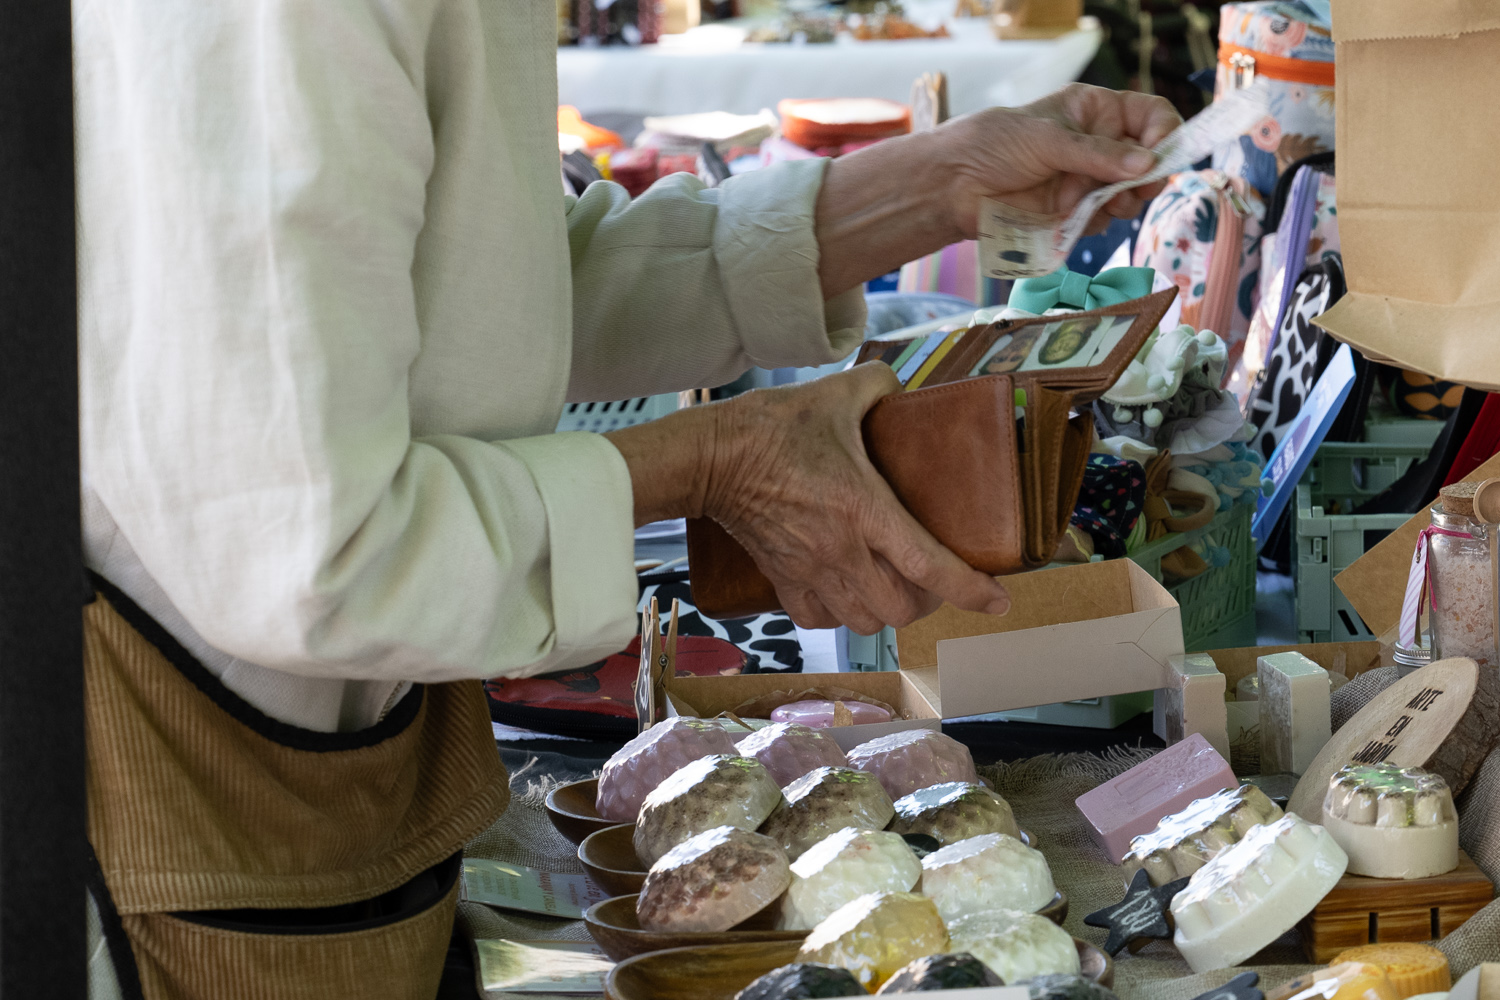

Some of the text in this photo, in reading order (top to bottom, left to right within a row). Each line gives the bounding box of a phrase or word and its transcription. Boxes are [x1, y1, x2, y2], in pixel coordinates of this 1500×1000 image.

[1405, 687, 1444, 712] ARTE
[1385, 715, 1413, 738] EN
[1352, 738, 1398, 765] JABÓN
